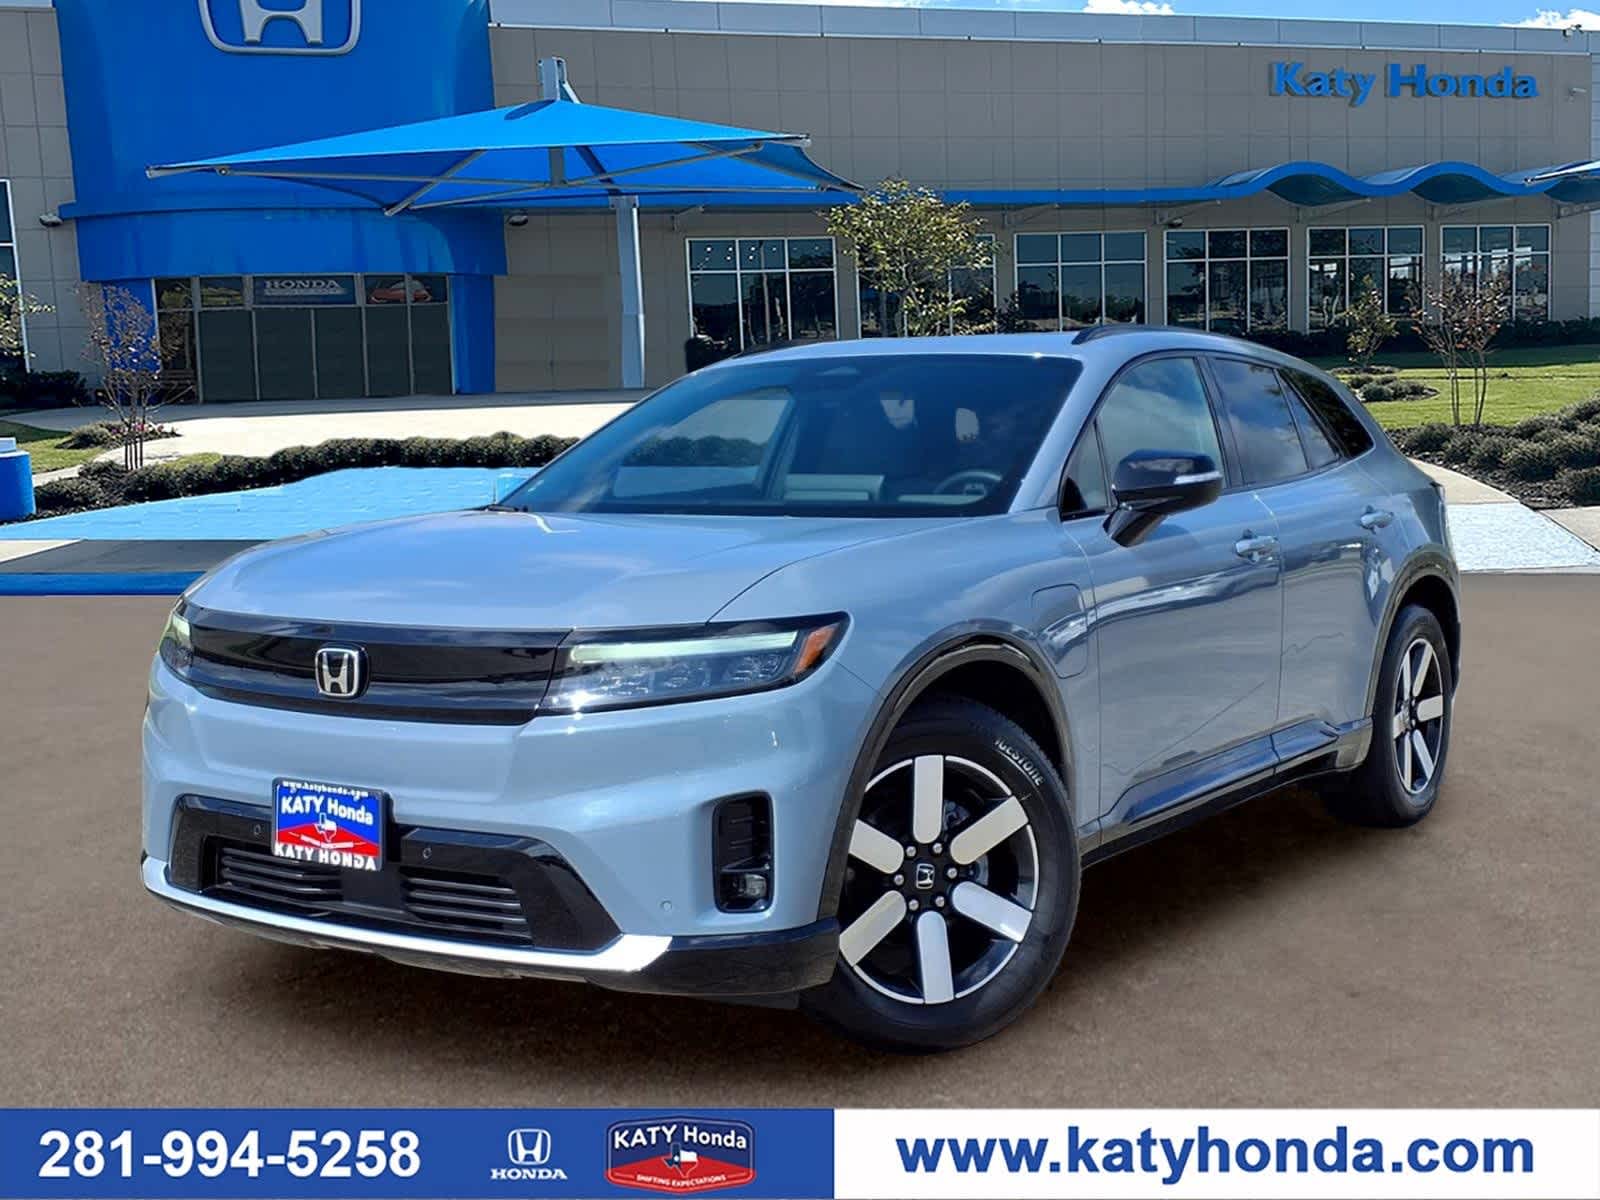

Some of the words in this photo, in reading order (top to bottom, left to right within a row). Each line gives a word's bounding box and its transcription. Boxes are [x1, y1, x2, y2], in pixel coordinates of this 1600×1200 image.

[1270, 62, 1376, 106] Katy
[1386, 62, 1539, 97] Honda
[264, 279, 341, 289] HONDA
[281, 795, 324, 814] KATY
[327, 797, 374, 825] Honda
[274, 841, 314, 860] KATY
[318, 849, 377, 871] HONDA
